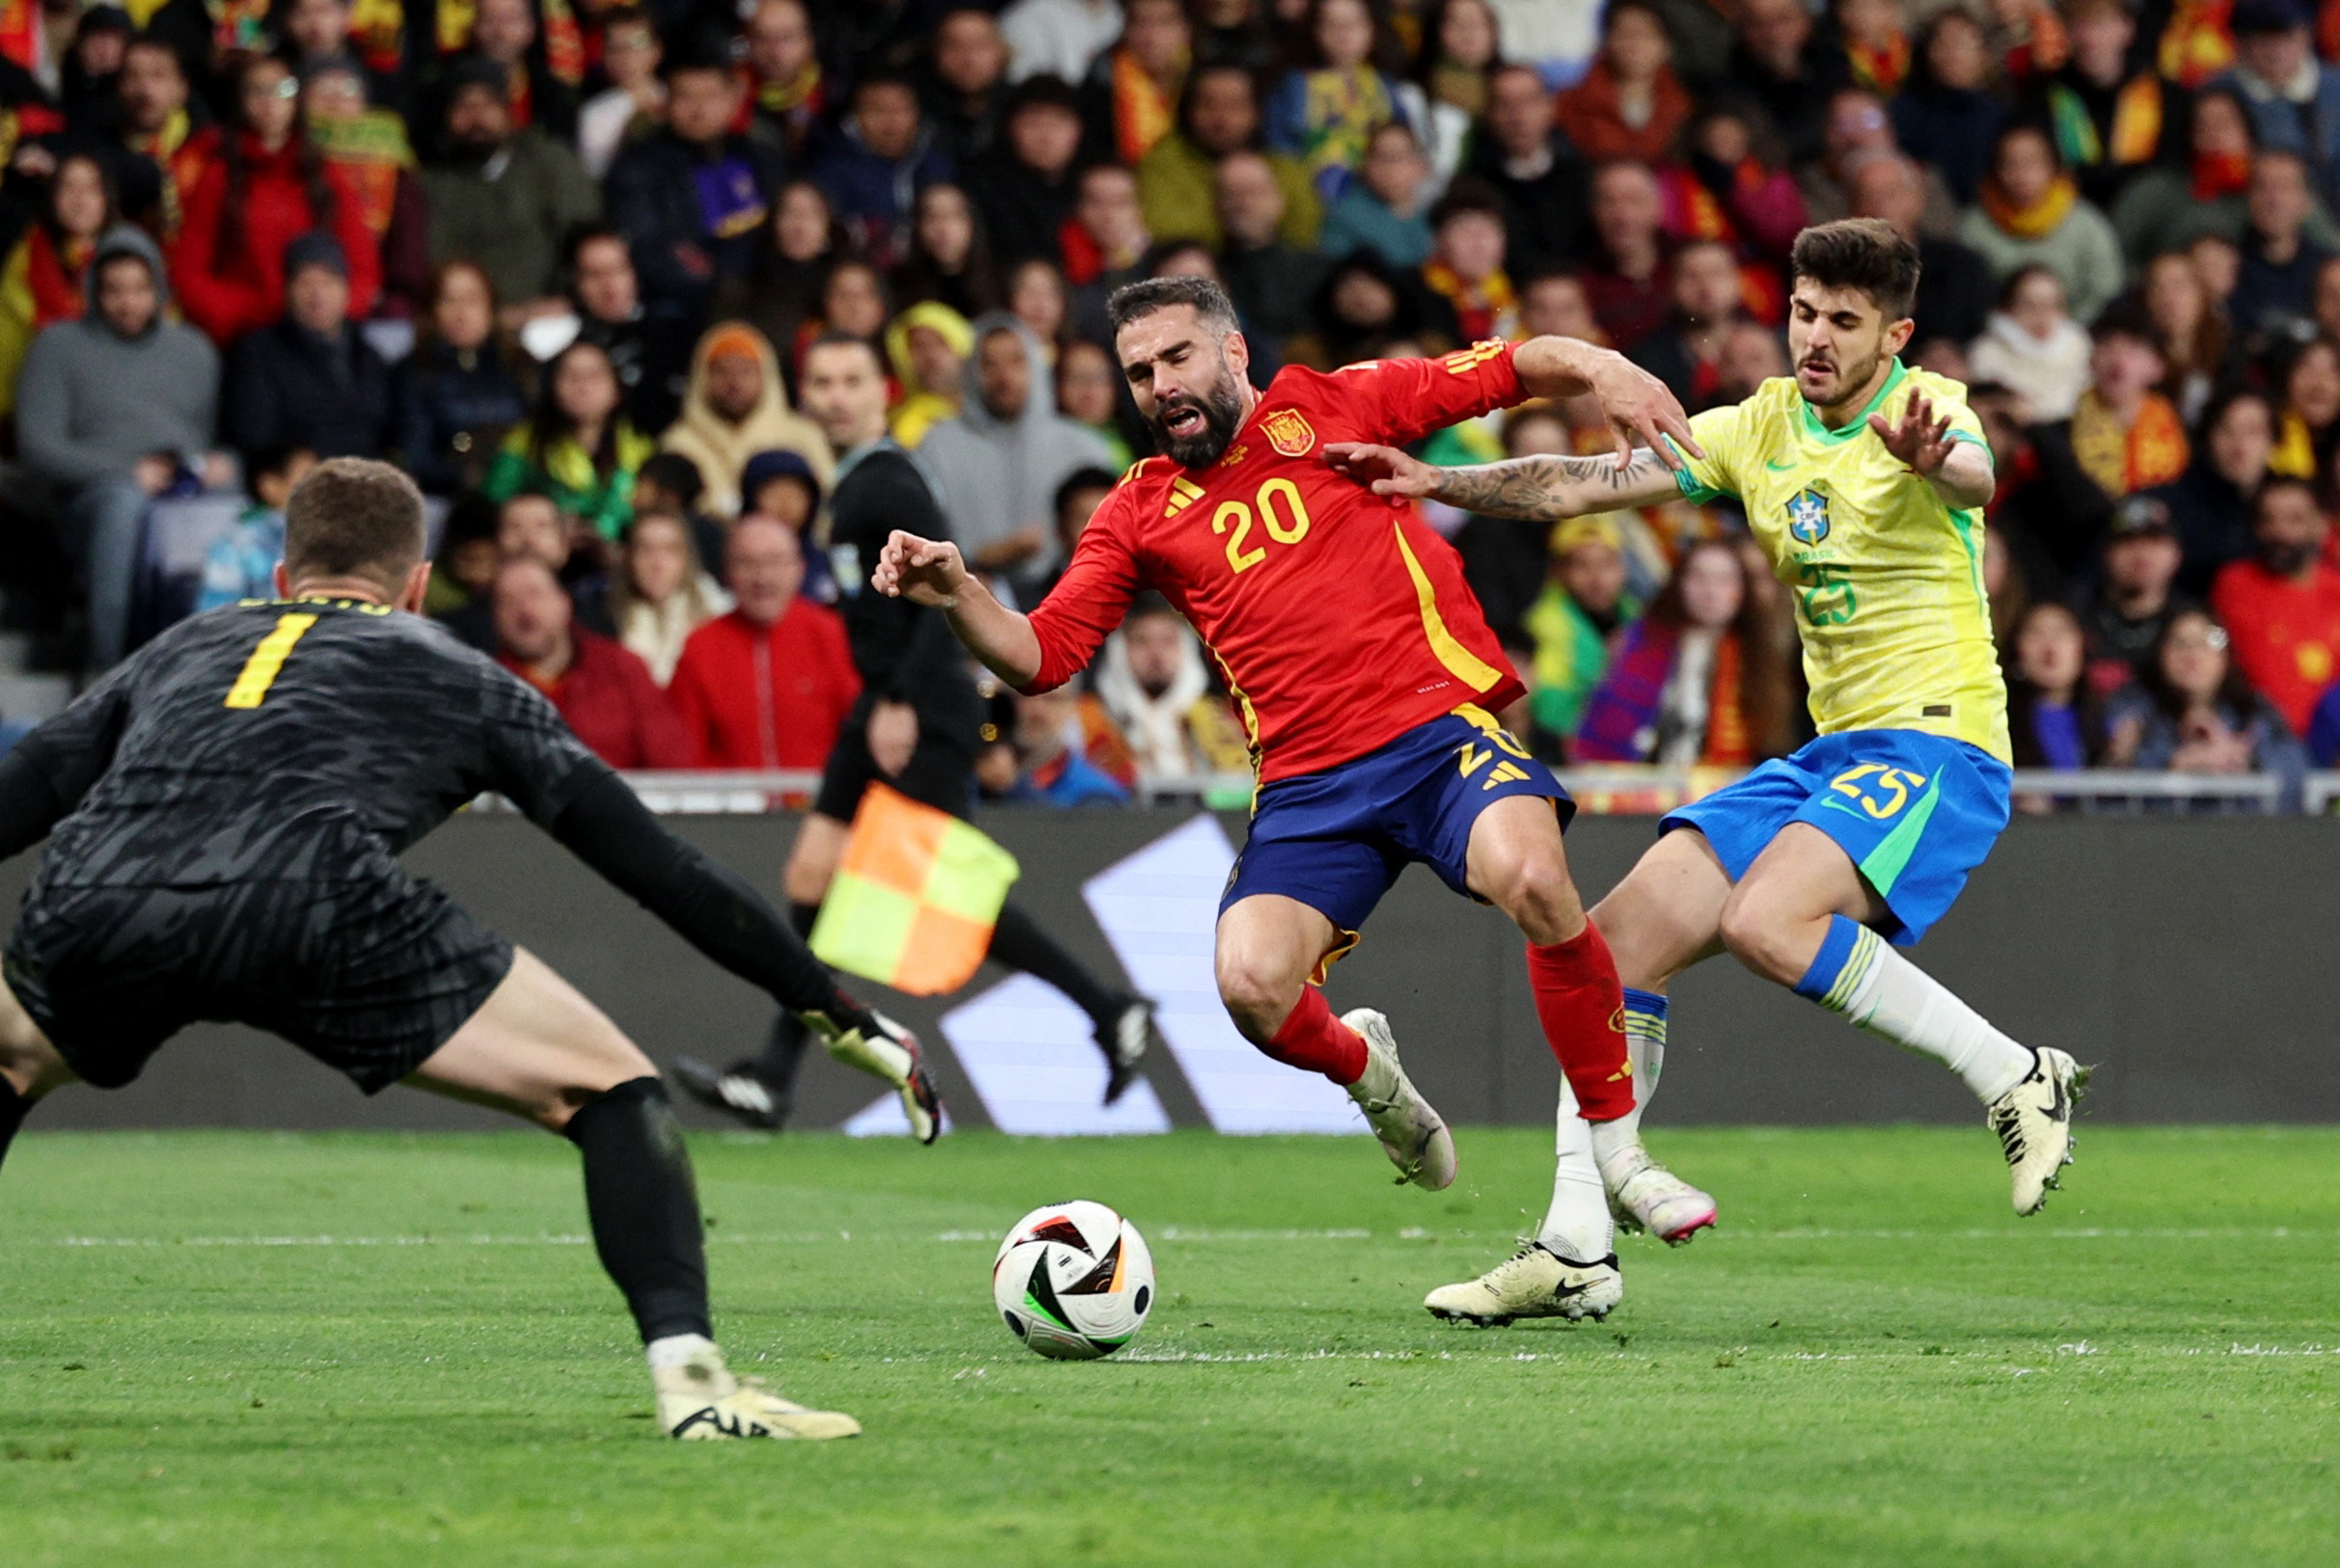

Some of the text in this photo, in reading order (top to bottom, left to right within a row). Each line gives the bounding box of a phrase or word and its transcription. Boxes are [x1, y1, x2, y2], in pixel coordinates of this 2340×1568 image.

[1211, 477, 1310, 575] 20
[1793, 549, 1835, 564] BRASIL
[1800, 563, 1857, 627] 25
[223, 612, 319, 709] 1
[1452, 728, 1533, 779] 20
[1830, 759, 1927, 820] 25
